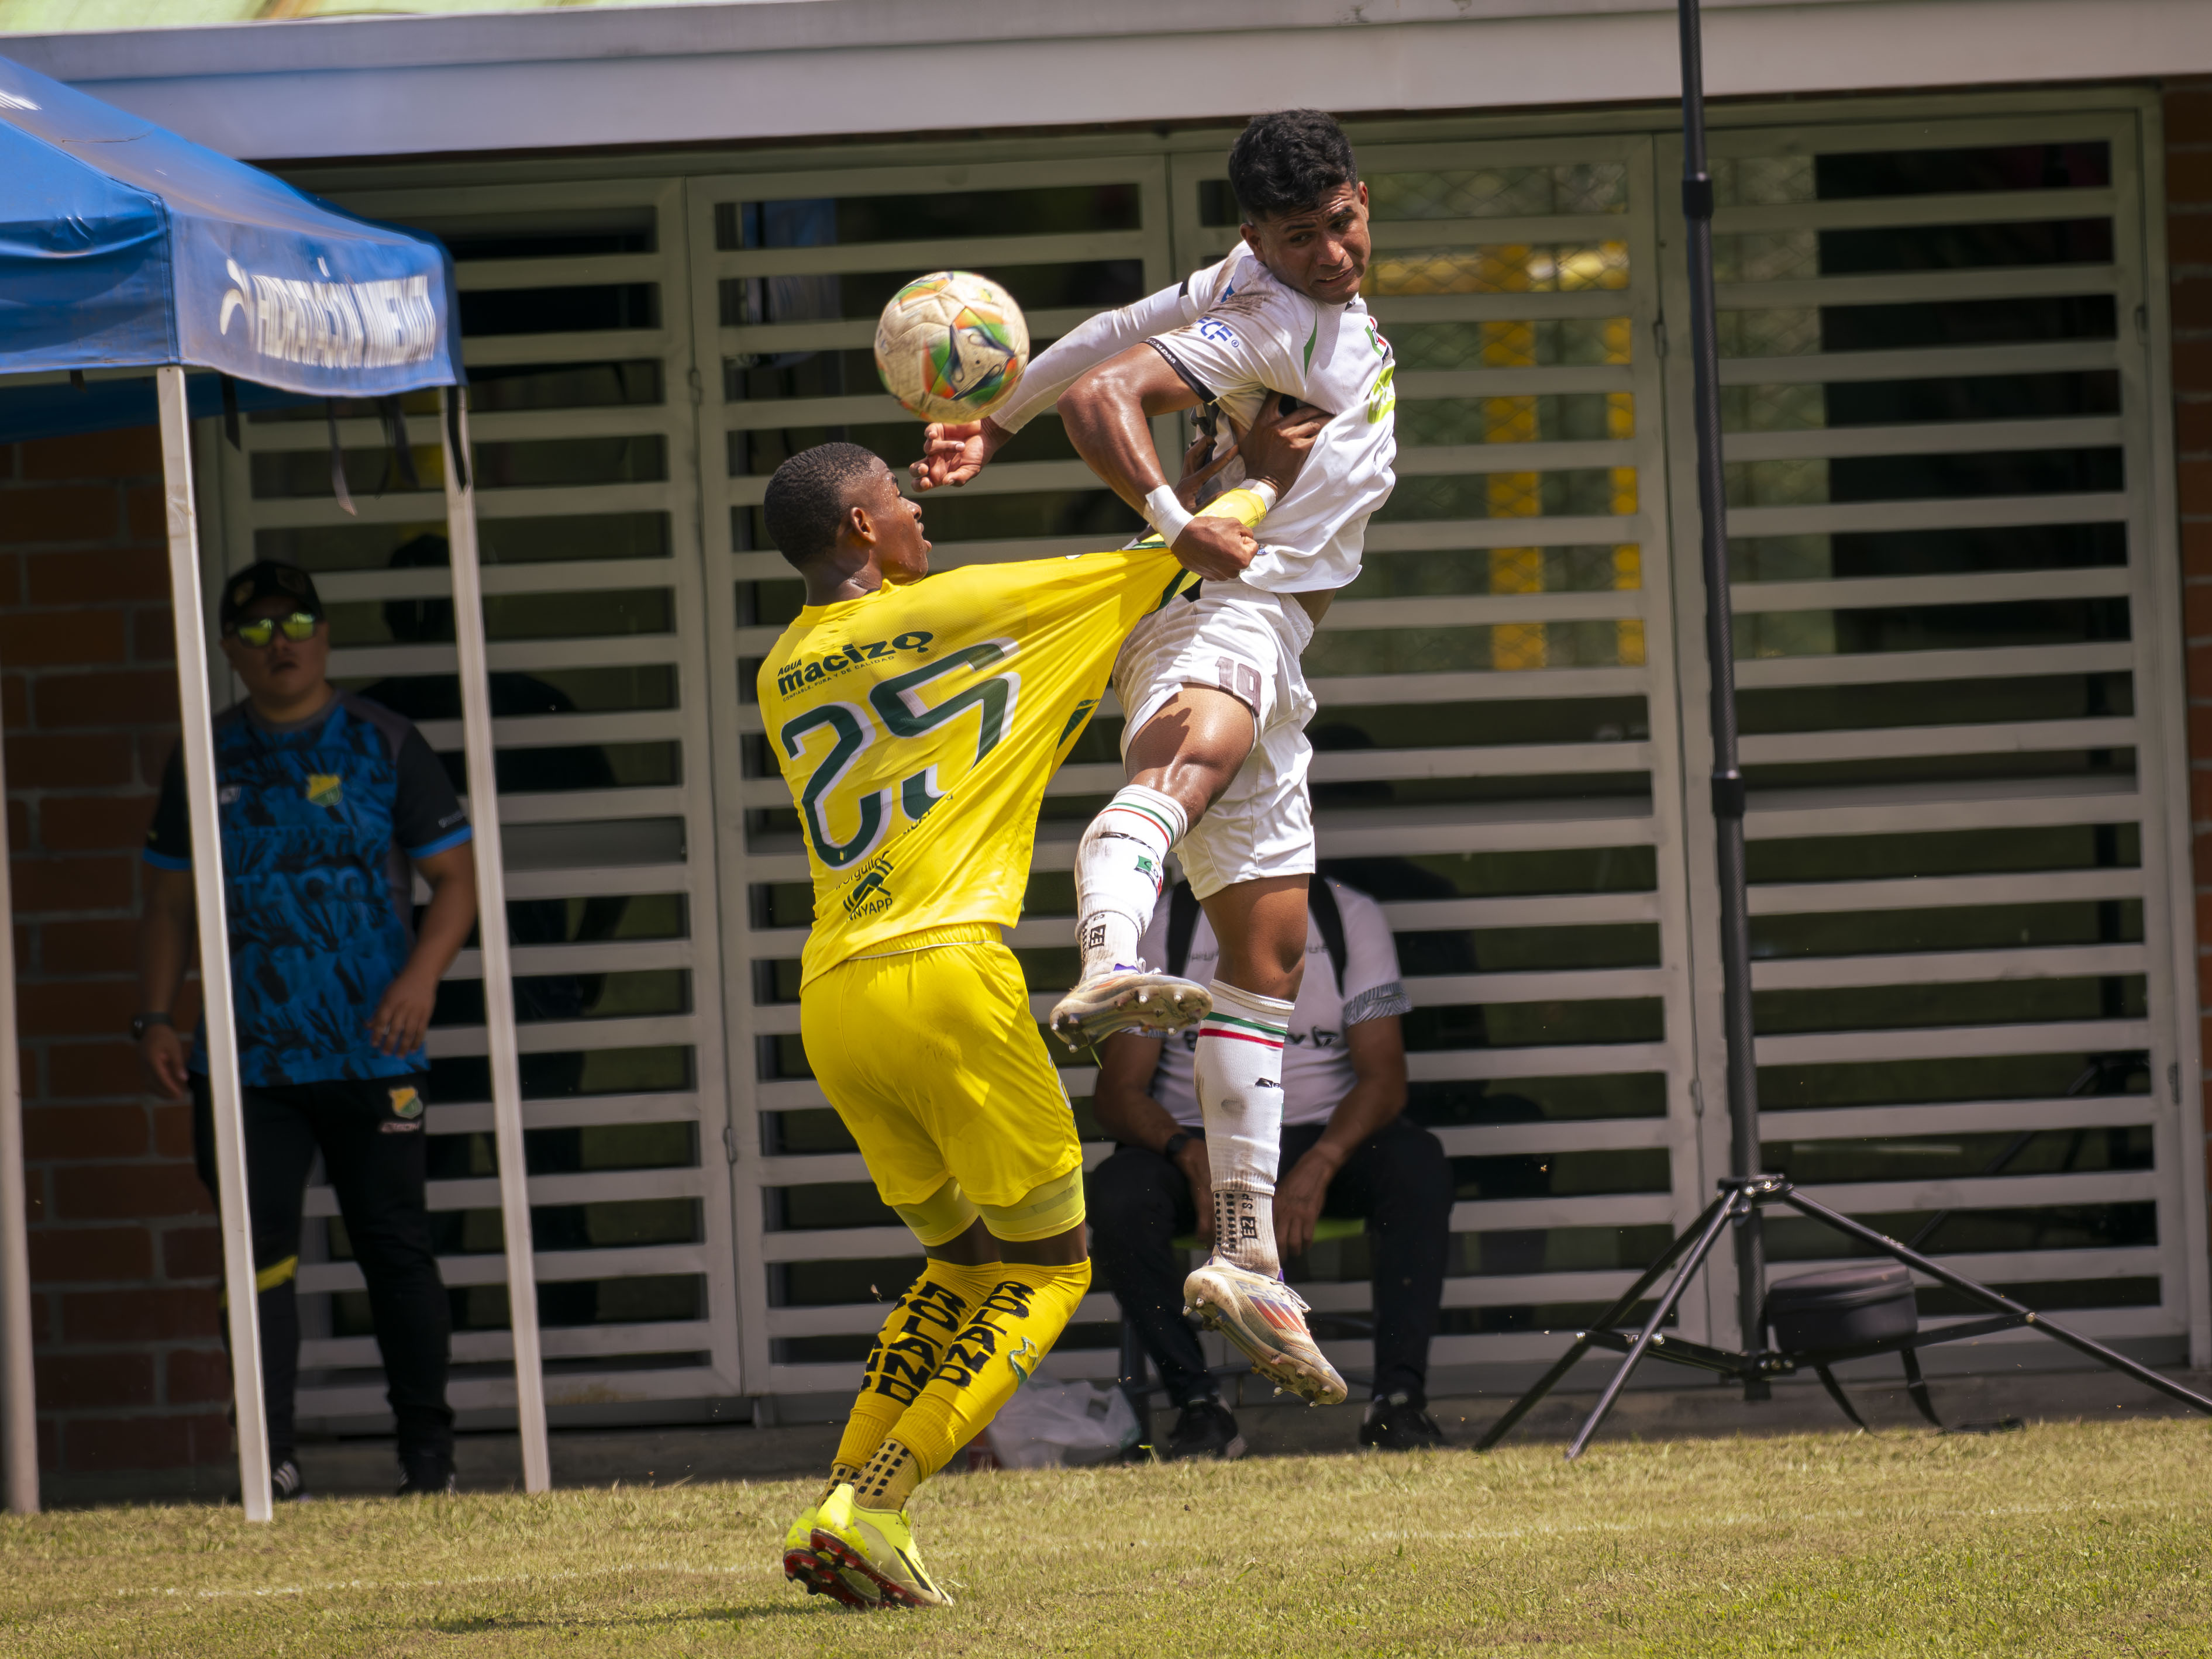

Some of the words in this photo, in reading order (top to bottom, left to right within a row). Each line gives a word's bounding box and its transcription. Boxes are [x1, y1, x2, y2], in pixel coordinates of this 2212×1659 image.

[777, 631, 933, 697] macizo
[778, 658, 802, 677] AGUA
[815, 676, 832, 687] PURA
[854, 656, 894, 669] CALIDAD
[781, 636, 1021, 870] 25
[1242, 1219, 1256, 1237] EZ
[876, 1281, 967, 1407] ROLAND
[929, 1280, 1036, 1388] ROLAND
